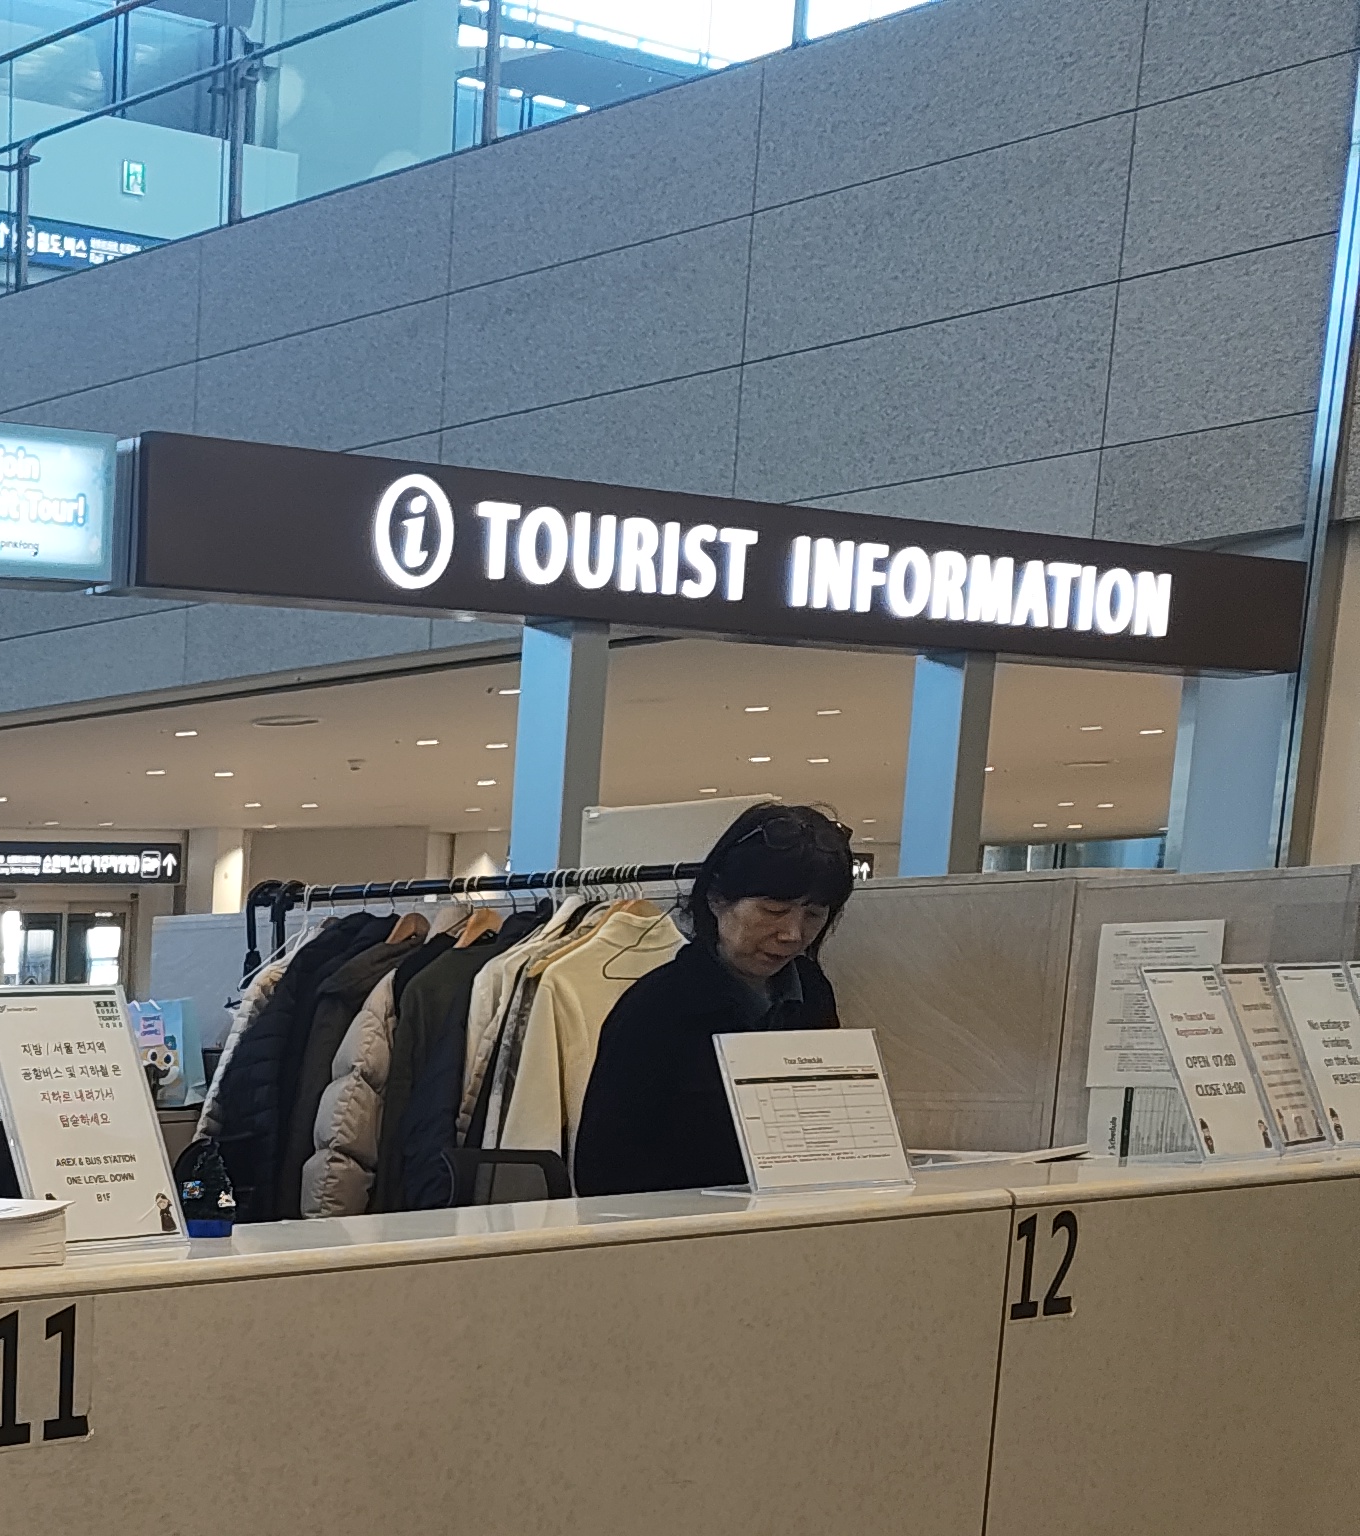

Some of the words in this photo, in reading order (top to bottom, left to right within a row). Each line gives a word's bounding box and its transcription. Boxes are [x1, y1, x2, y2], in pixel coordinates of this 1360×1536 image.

[477, 499, 758, 601] TOURIST
[789, 534, 1173, 637] INFORMATION
[1009, 1211, 1078, 1320] 12
